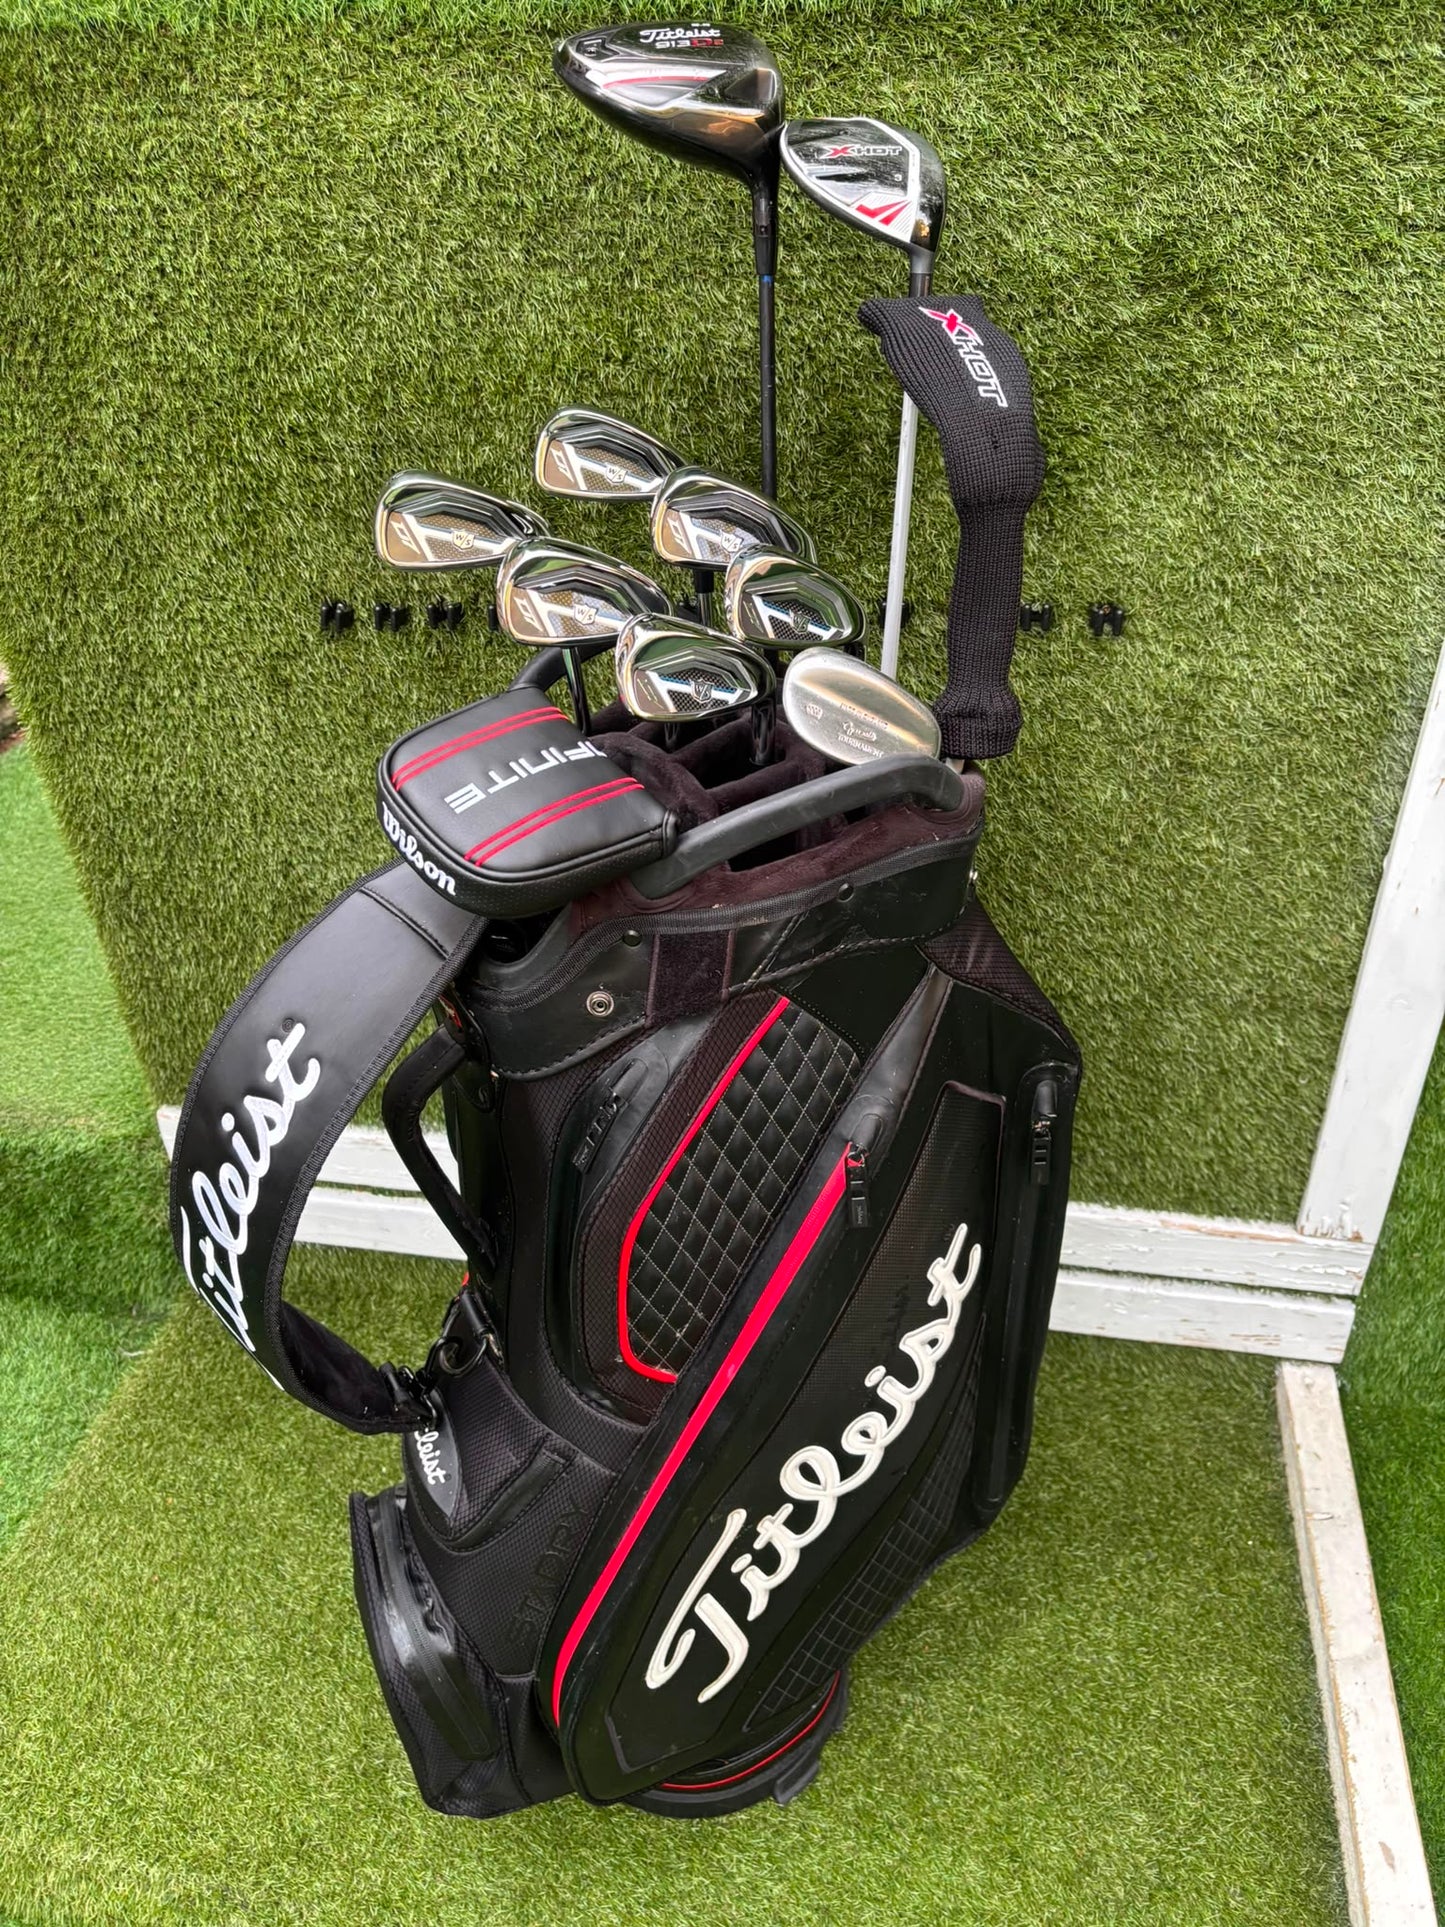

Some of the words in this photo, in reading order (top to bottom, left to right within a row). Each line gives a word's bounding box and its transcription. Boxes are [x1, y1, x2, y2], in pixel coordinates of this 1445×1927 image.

[639, 28, 721, 43] Titleist
[382, 801, 456, 896] Wilson
[645, 1223, 981, 1703] Titleist
